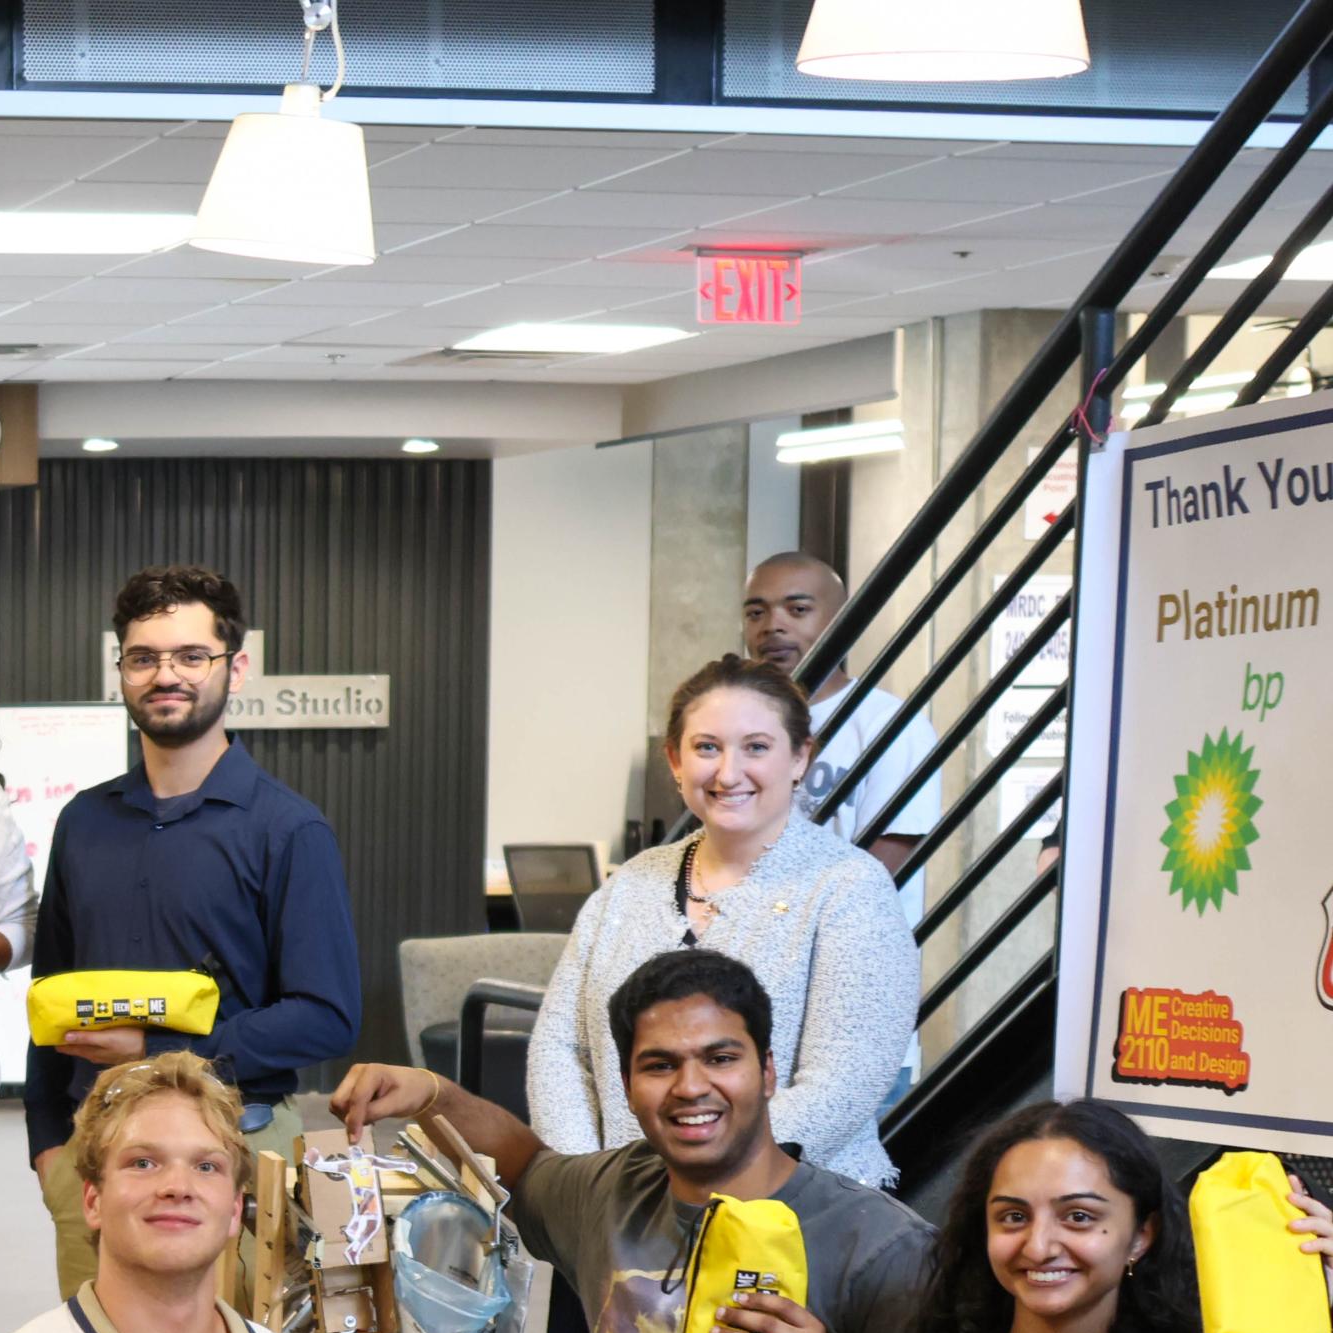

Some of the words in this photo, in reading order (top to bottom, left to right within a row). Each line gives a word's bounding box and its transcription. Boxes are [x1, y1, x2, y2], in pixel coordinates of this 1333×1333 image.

[714, 258, 790, 322] EXIT
[1144, 464, 1250, 528] Thank
[1257, 457, 1333, 510] You
[1157, 584, 1320, 643] Platinum
[276, 685, 383, 716] Studio
[1241, 662, 1285, 722] bp
[149, 1000, 165, 1013] ME
[1126, 995, 1170, 1036] ME
[1172, 997, 1229, 1019] Creative
[1171, 1020, 1239, 1044] Decisions
[1121, 1035, 1170, 1072] 2110
[1170, 1051, 1196, 1070] and
[1199, 1052, 1246, 1080] Design
[736, 1272, 757, 1288] ME
